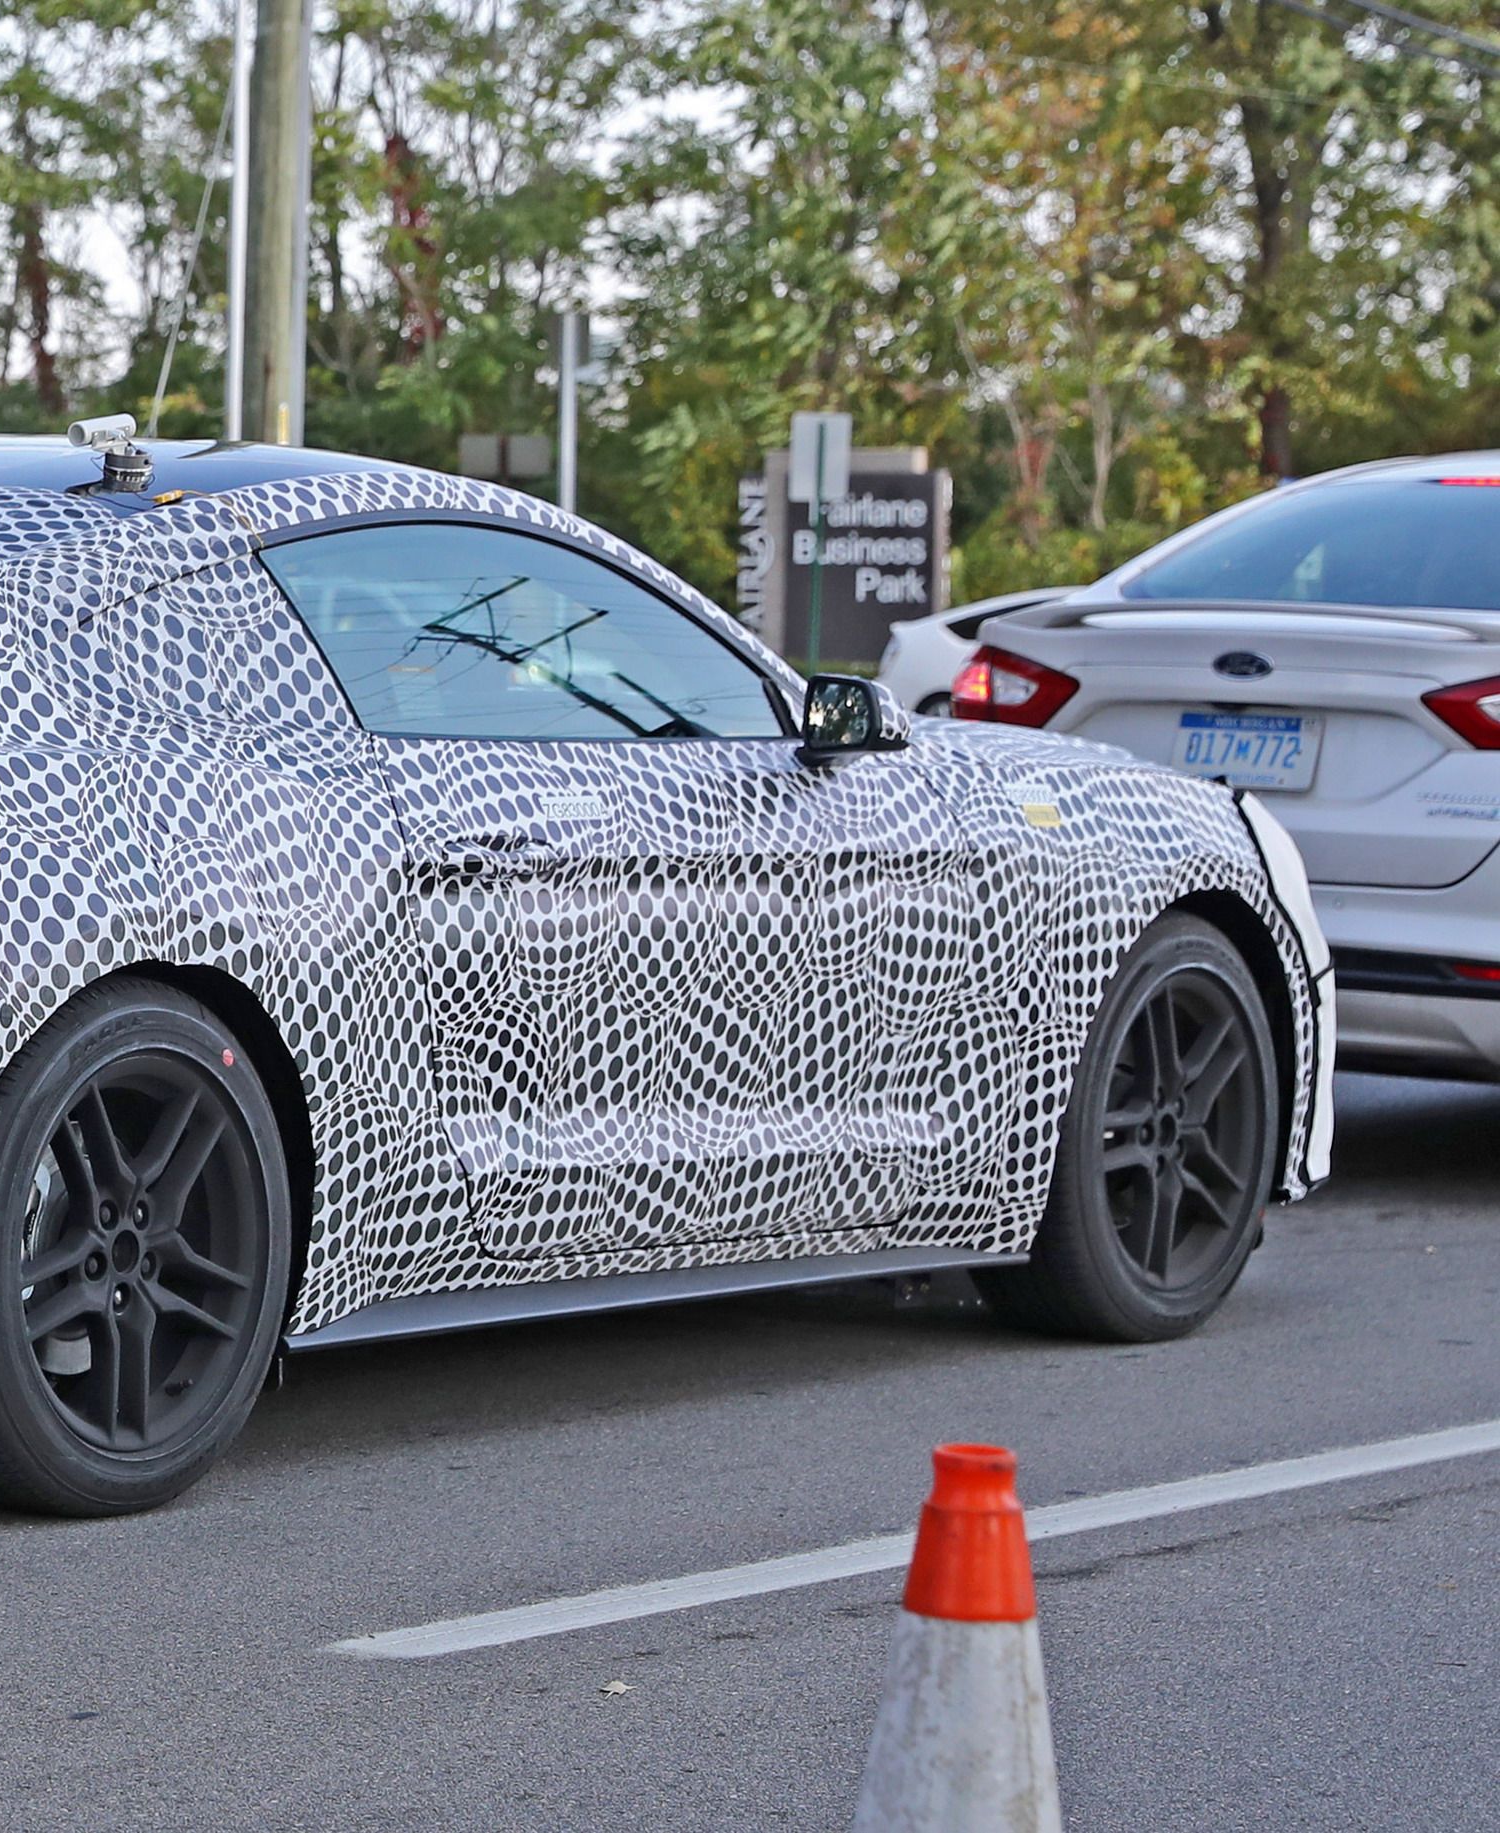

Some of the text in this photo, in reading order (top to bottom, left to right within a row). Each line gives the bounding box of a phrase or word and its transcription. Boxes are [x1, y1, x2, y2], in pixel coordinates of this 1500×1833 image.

[737, 477, 776, 634] AIRLANE
[855, 567, 928, 604] Park
[1185, 732, 1300, 769] 017M772
[543, 801, 608, 819] ZG830004
